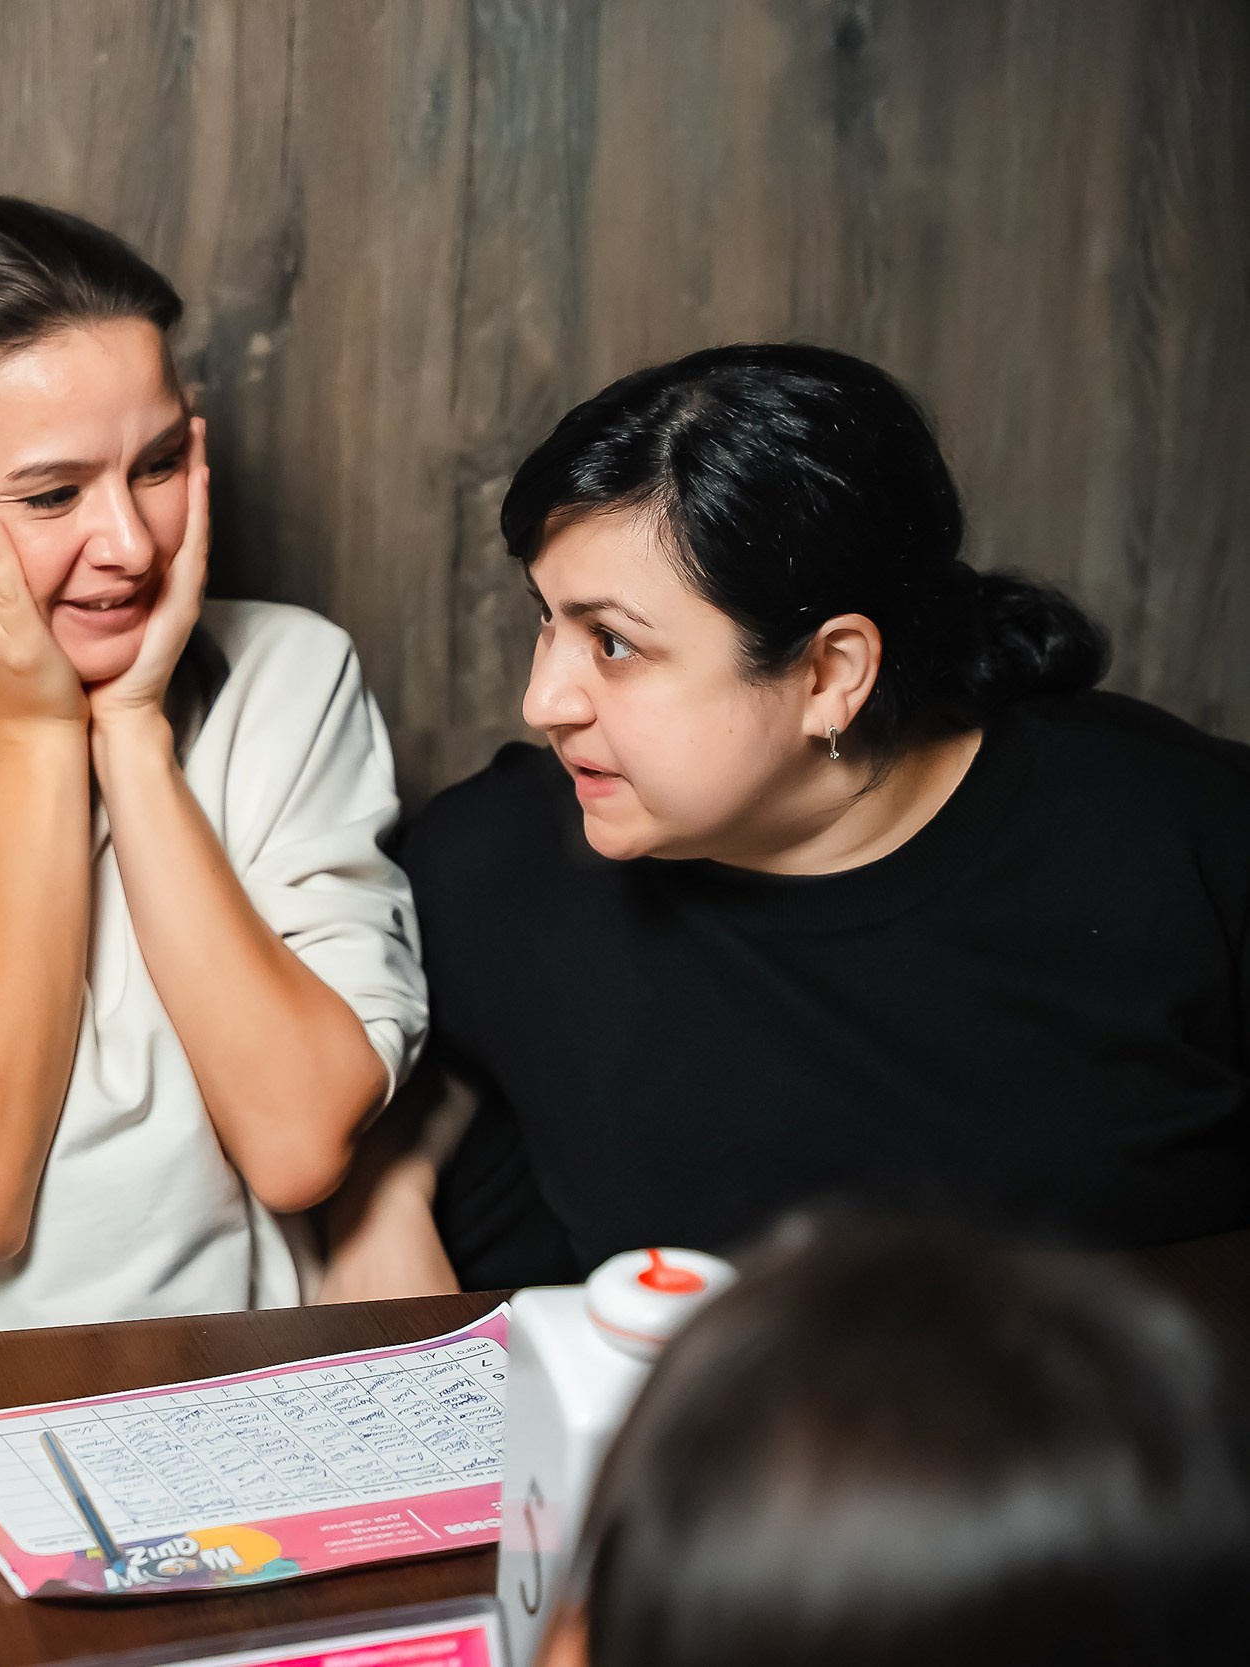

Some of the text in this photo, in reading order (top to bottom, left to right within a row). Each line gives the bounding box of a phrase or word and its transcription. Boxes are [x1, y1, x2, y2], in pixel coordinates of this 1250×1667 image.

[475, 1359, 493, 1367] 7
[369, 1512, 405, 1523] ДЛЯ
[349, 1520, 412, 1535] КОМАНД
[129, 1538, 199, 1564] QUIZ
